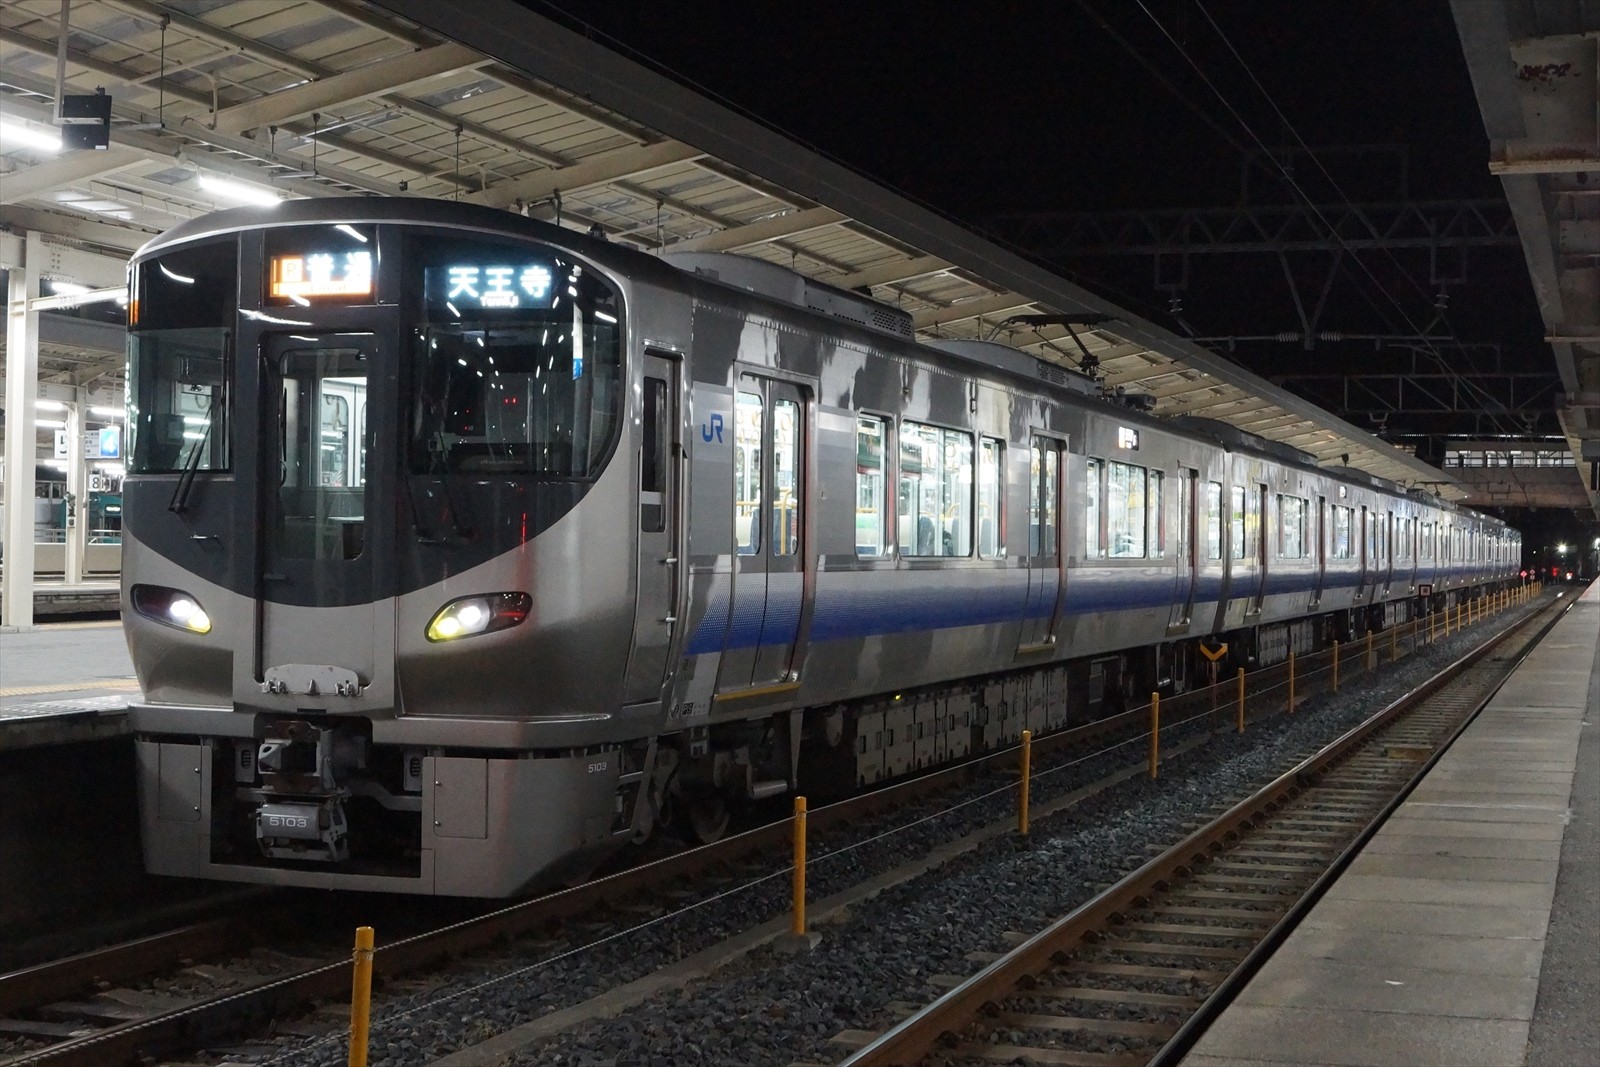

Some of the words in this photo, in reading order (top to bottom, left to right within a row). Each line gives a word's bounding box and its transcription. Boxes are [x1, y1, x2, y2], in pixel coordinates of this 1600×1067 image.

[448, 265, 552, 298] 天王寺
[702, 413, 723, 444] JR
[92, 477, 100, 489] 8
[588, 762, 607, 773] 5103
[269, 817, 307, 828] 5103
